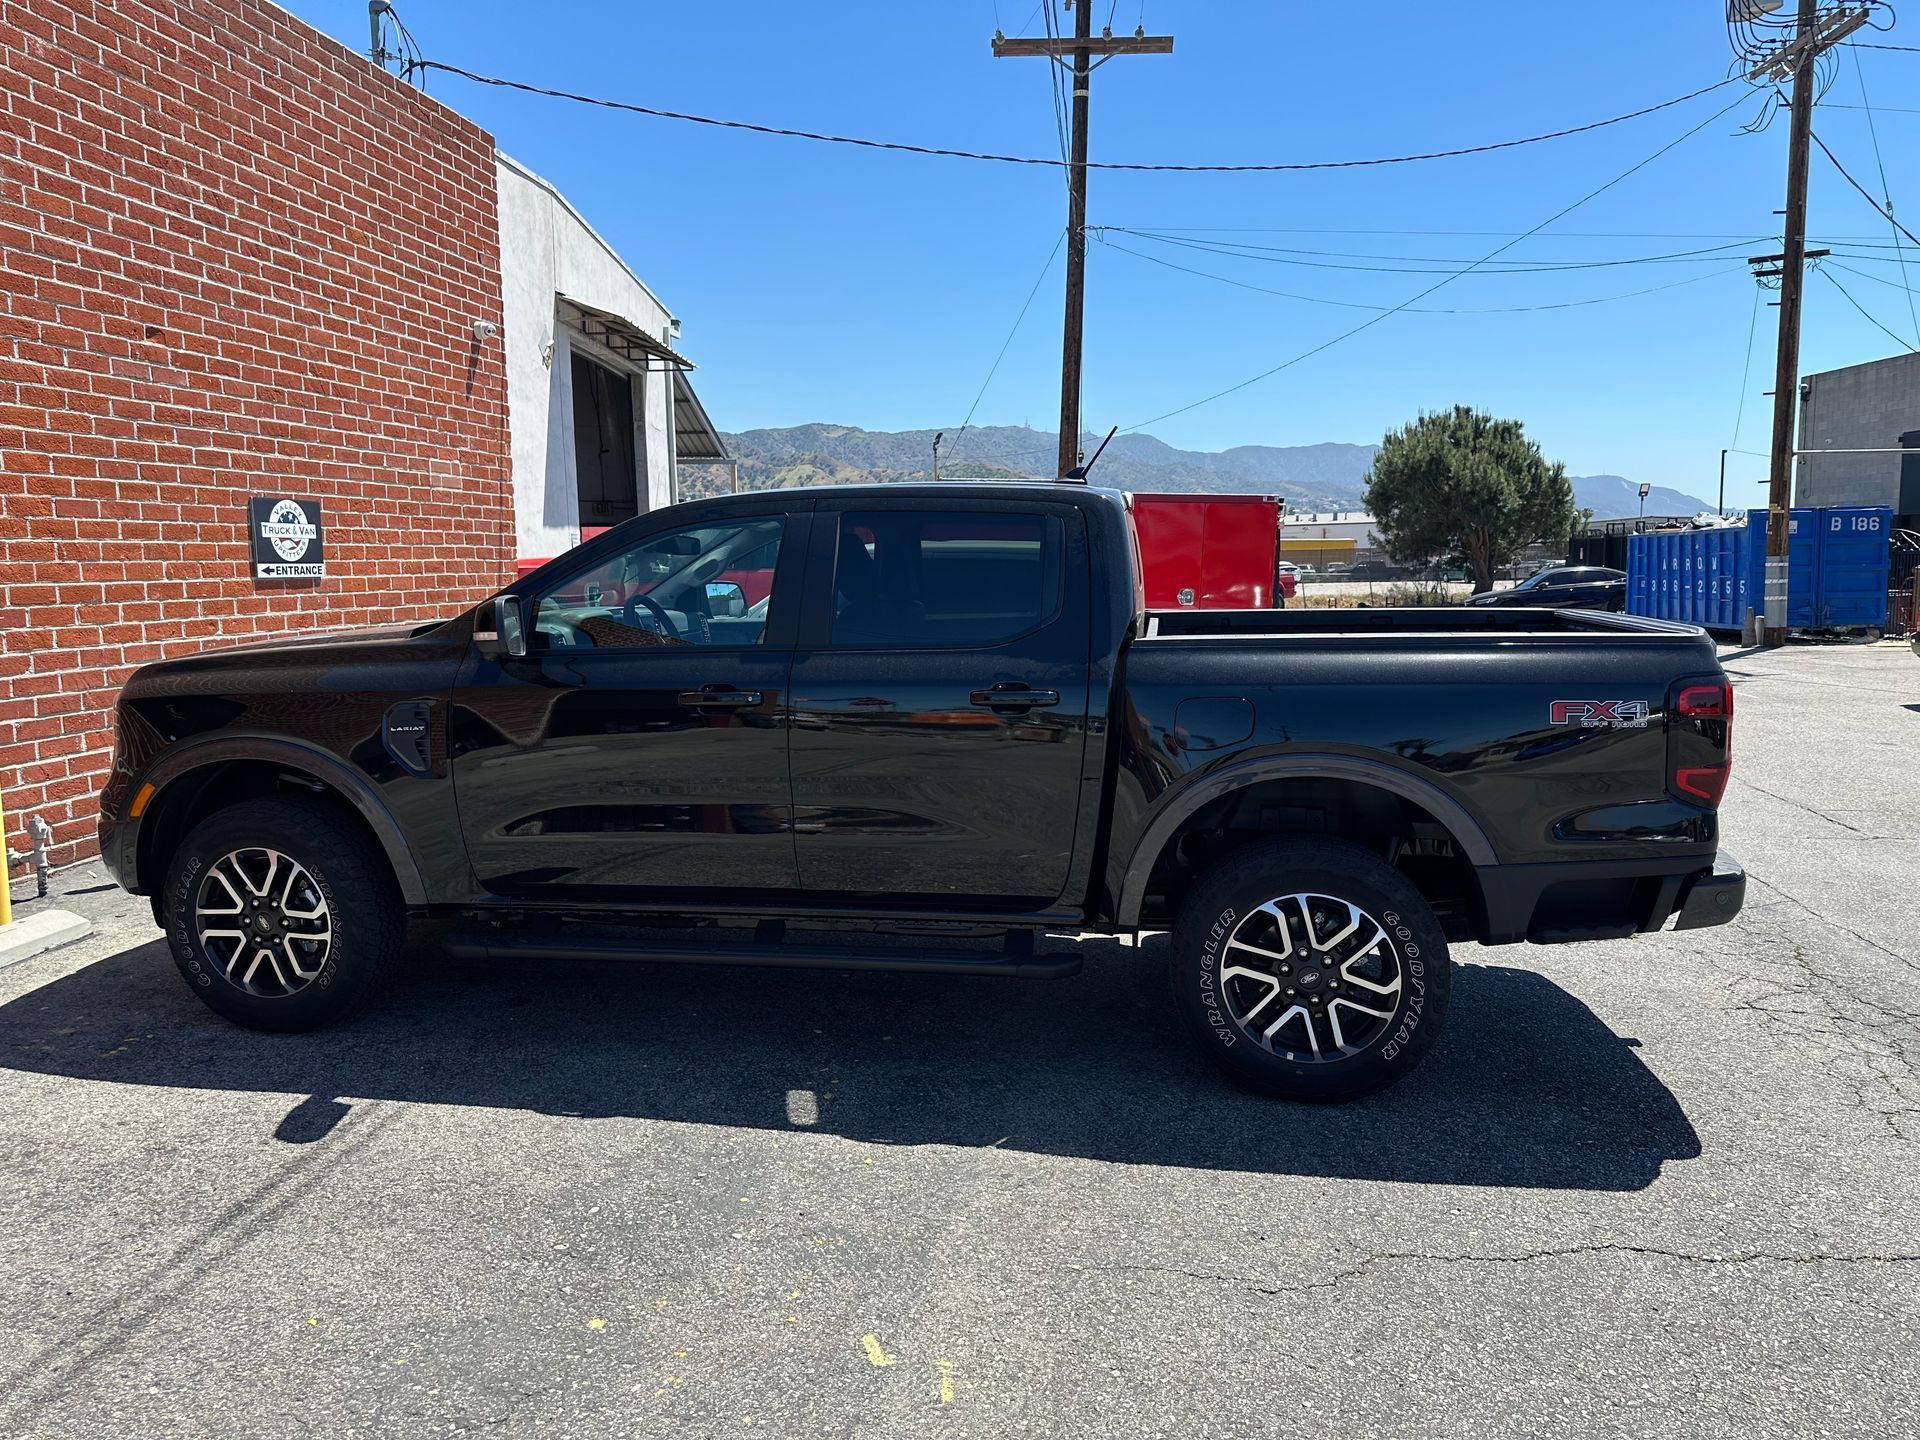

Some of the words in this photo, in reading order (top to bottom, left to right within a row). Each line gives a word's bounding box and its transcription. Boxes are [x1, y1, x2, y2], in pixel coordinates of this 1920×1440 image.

[274, 503, 303, 517] VALLEY
[262, 524, 291, 535] TRUCK
[292, 525, 298, 536] &
[299, 526, 316, 536] VAN
[1830, 516, 1842, 531] B
[1851, 516, 1880, 531] 186
[273, 539, 307, 559] UPFITTERS
[276, 565, 323, 576] ENTRANCE
[1662, 557, 1718, 571] ARROW
[1651, 579, 1746, 595] 336-2255
[1549, 700, 1650, 725] FX4
[175, 856, 212, 988] GOODYEAR
[309, 864, 344, 991] WRANGLER
[1199, 908, 1237, 1048] WRANGLER
[1382, 909, 1426, 1060] GOODYEAR
